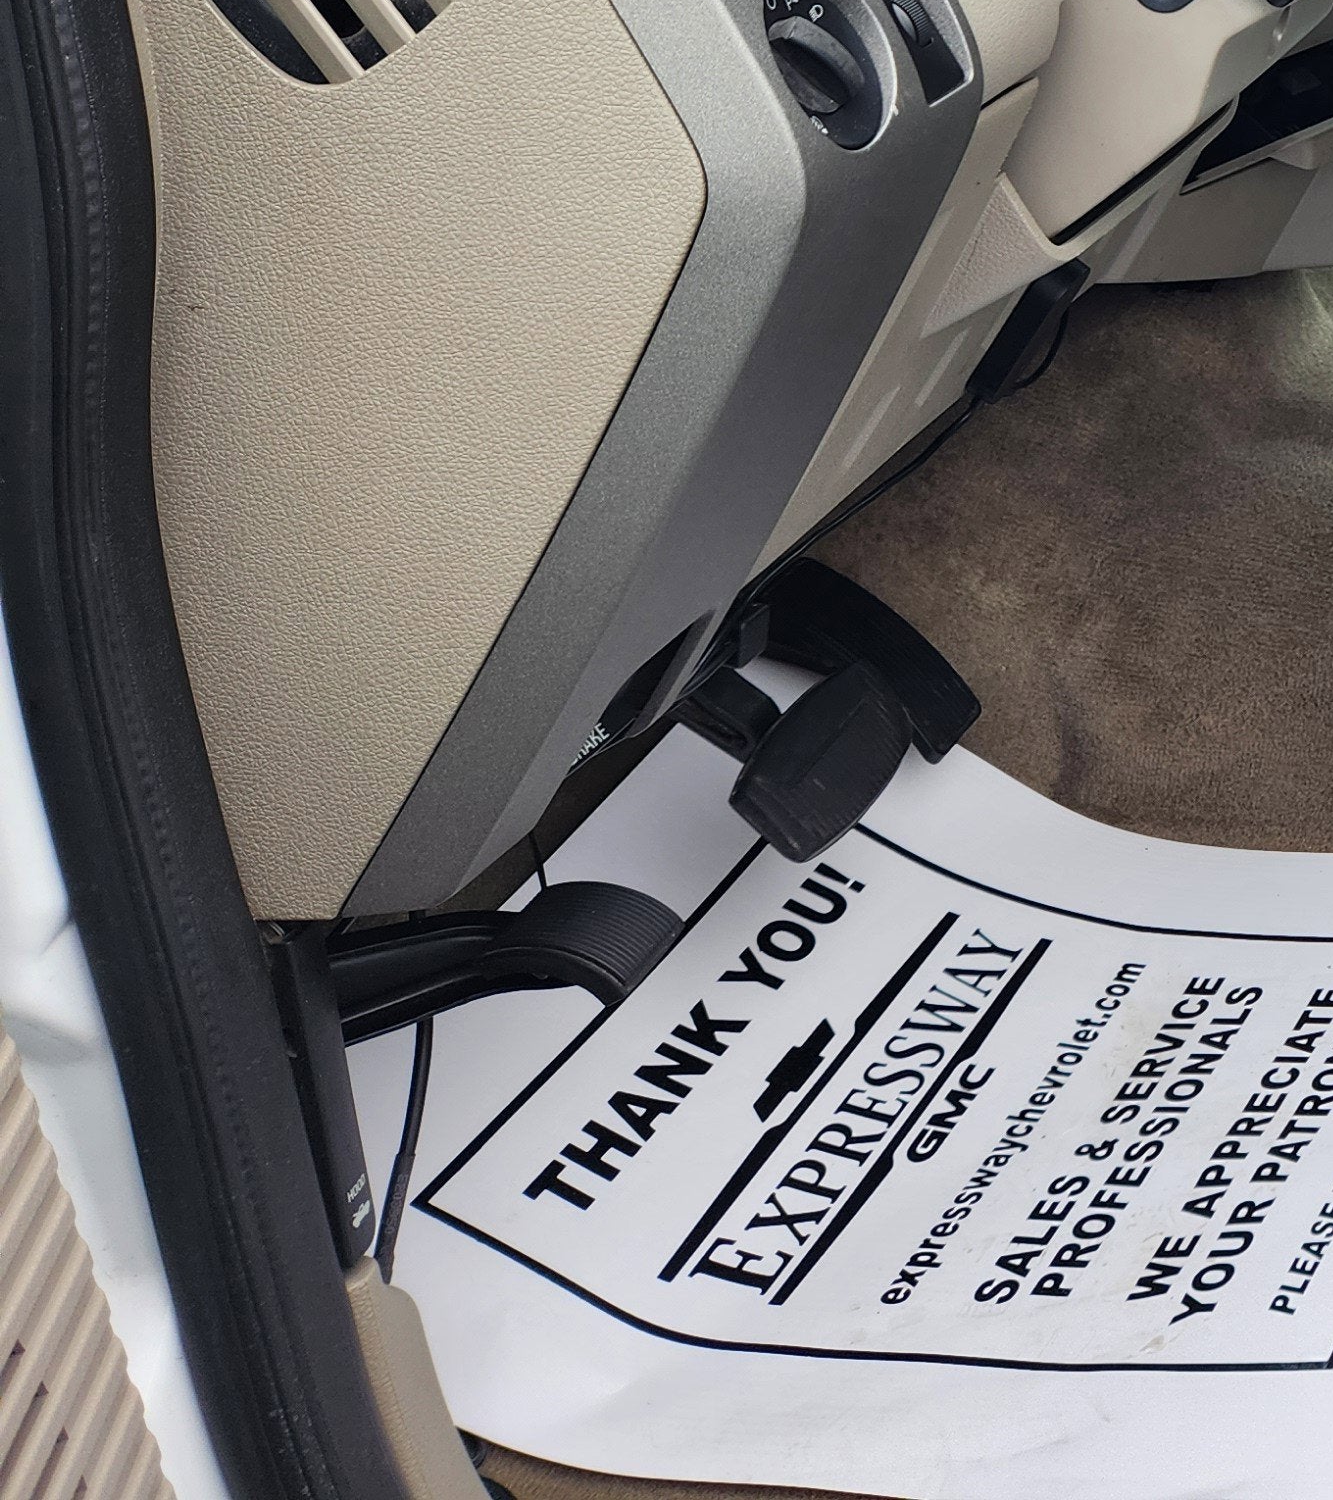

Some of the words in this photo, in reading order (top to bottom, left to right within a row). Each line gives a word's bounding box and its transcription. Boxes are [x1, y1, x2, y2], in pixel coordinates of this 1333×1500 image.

[346, 1173, 366, 1203] HOOD
[522, 998, 752, 1211] THANK
[716, 862, 866, 991] YOU!
[687, 928, 1024, 1296] EXPRESSWAY
[880, 963, 1147, 1305] expresswaychevrolet.com
[906, 1063, 996, 1163] GMC
[973, 1175, 1091, 1305] SALES
[1074, 1138, 1120, 1161] &
[1100, 976, 1226, 1125] SERVICE
[1030, 986, 1264, 1297] PROFESSIONALS
[1126, 1234, 1202, 1301] WE
[1169, 1198, 1276, 1326] YOUR
